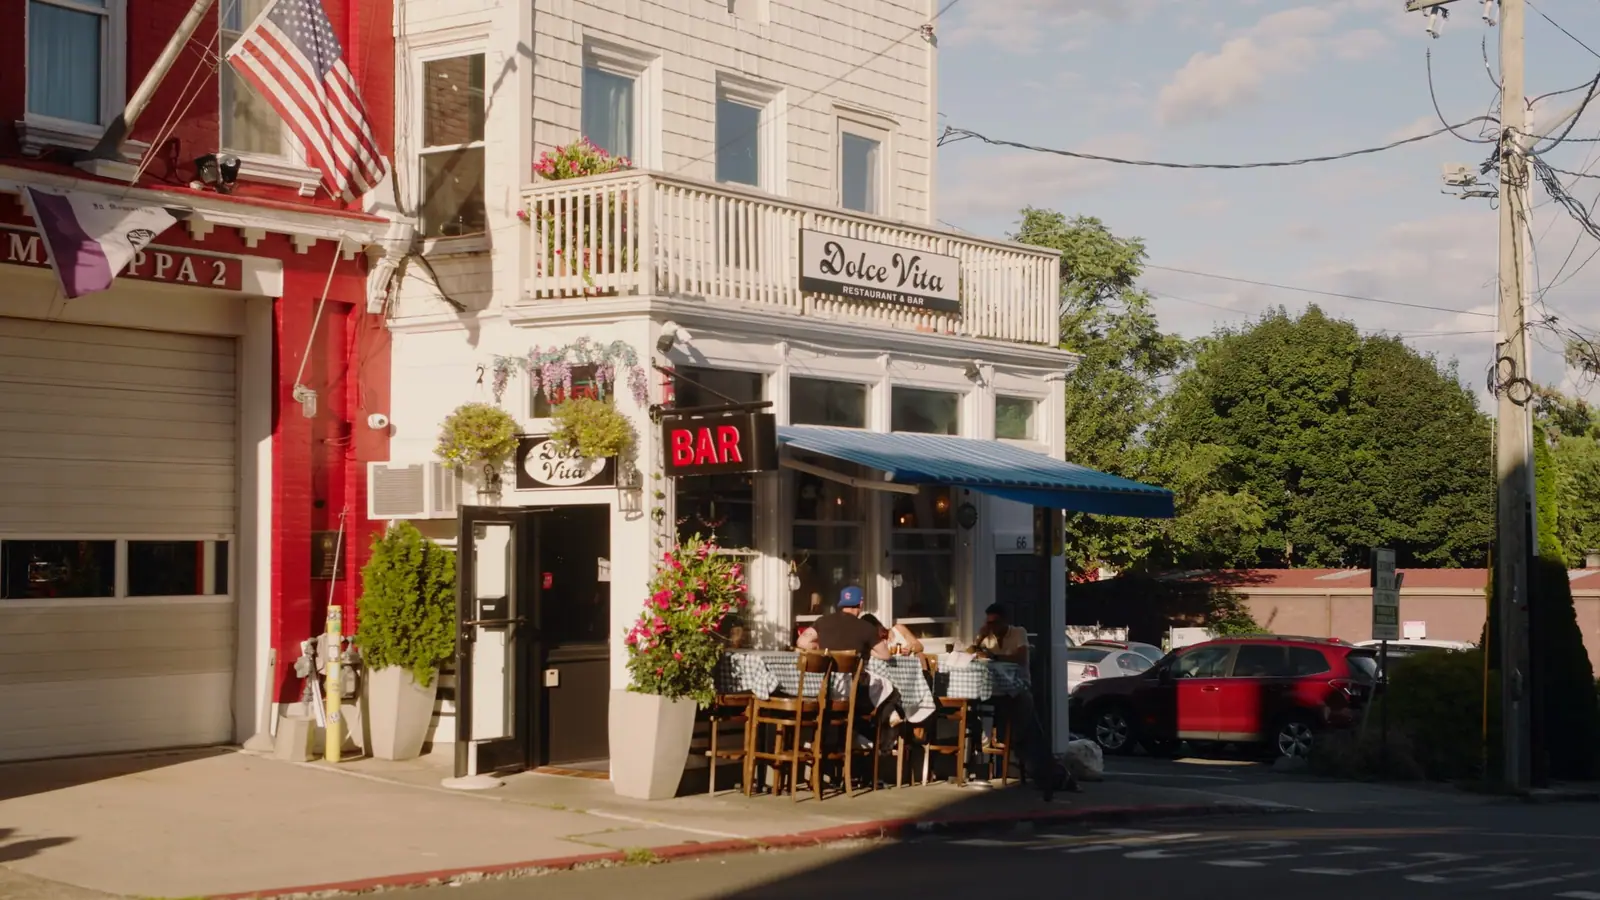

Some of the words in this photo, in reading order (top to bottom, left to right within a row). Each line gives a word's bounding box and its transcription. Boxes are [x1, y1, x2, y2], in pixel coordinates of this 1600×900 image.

[8, 232, 198, 283] MPPA
[211, 260, 226, 285] 2
[819, 241, 889, 283] Dolce
[891, 252, 945, 292] Vita
[842, 285, 898, 302] RESTAURANT
[899, 295, 905, 303] &
[907, 295, 924, 305] BAR
[475, 366, 485, 384] 2
[671, 425, 743, 467] BAR
[542, 461, 586, 480] Vita
[1016, 536, 1027, 549] 66
